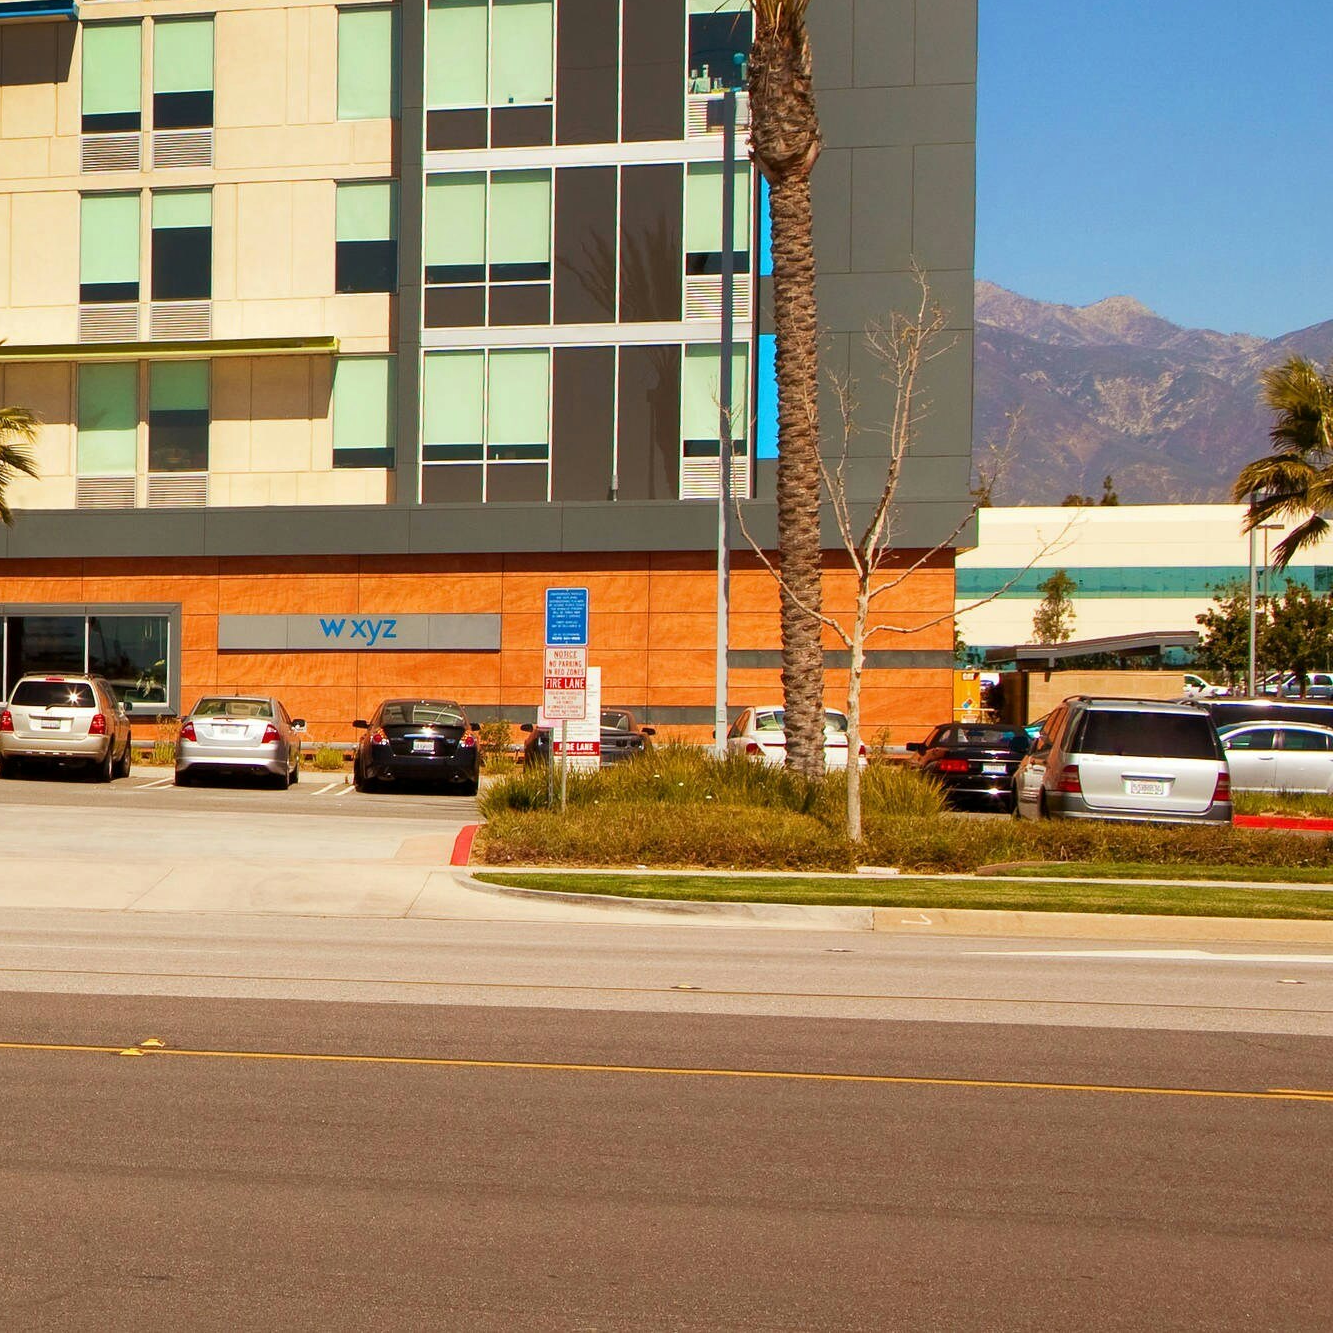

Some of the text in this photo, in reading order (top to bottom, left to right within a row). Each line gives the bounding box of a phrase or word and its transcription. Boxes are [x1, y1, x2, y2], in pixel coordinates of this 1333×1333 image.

[554, 650, 577, 659] NOTICE
[549, 660, 582, 668] NO PARKING
[566, 668, 584, 676] ZONES
[545, 678, 585, 689] FIRE LANE
